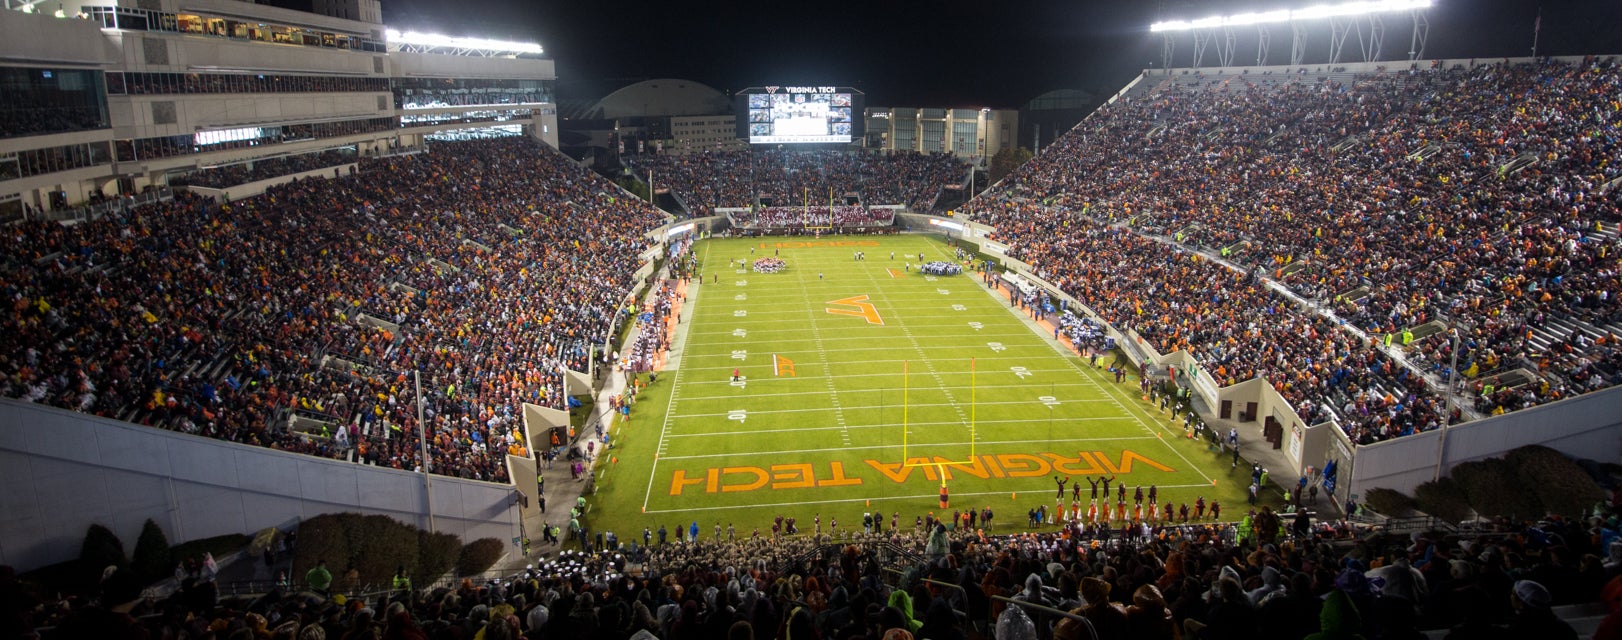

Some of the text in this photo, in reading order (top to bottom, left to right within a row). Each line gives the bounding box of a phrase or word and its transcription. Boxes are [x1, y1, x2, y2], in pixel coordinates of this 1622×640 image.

[785, 86, 836, 94] VIRGINIA TECH
[1010, 366, 1033, 377] 20
[1038, 395, 1062, 406] 10
[727, 409, 747, 420] 10
[669, 450, 1176, 496] VIRGINIA TECH
